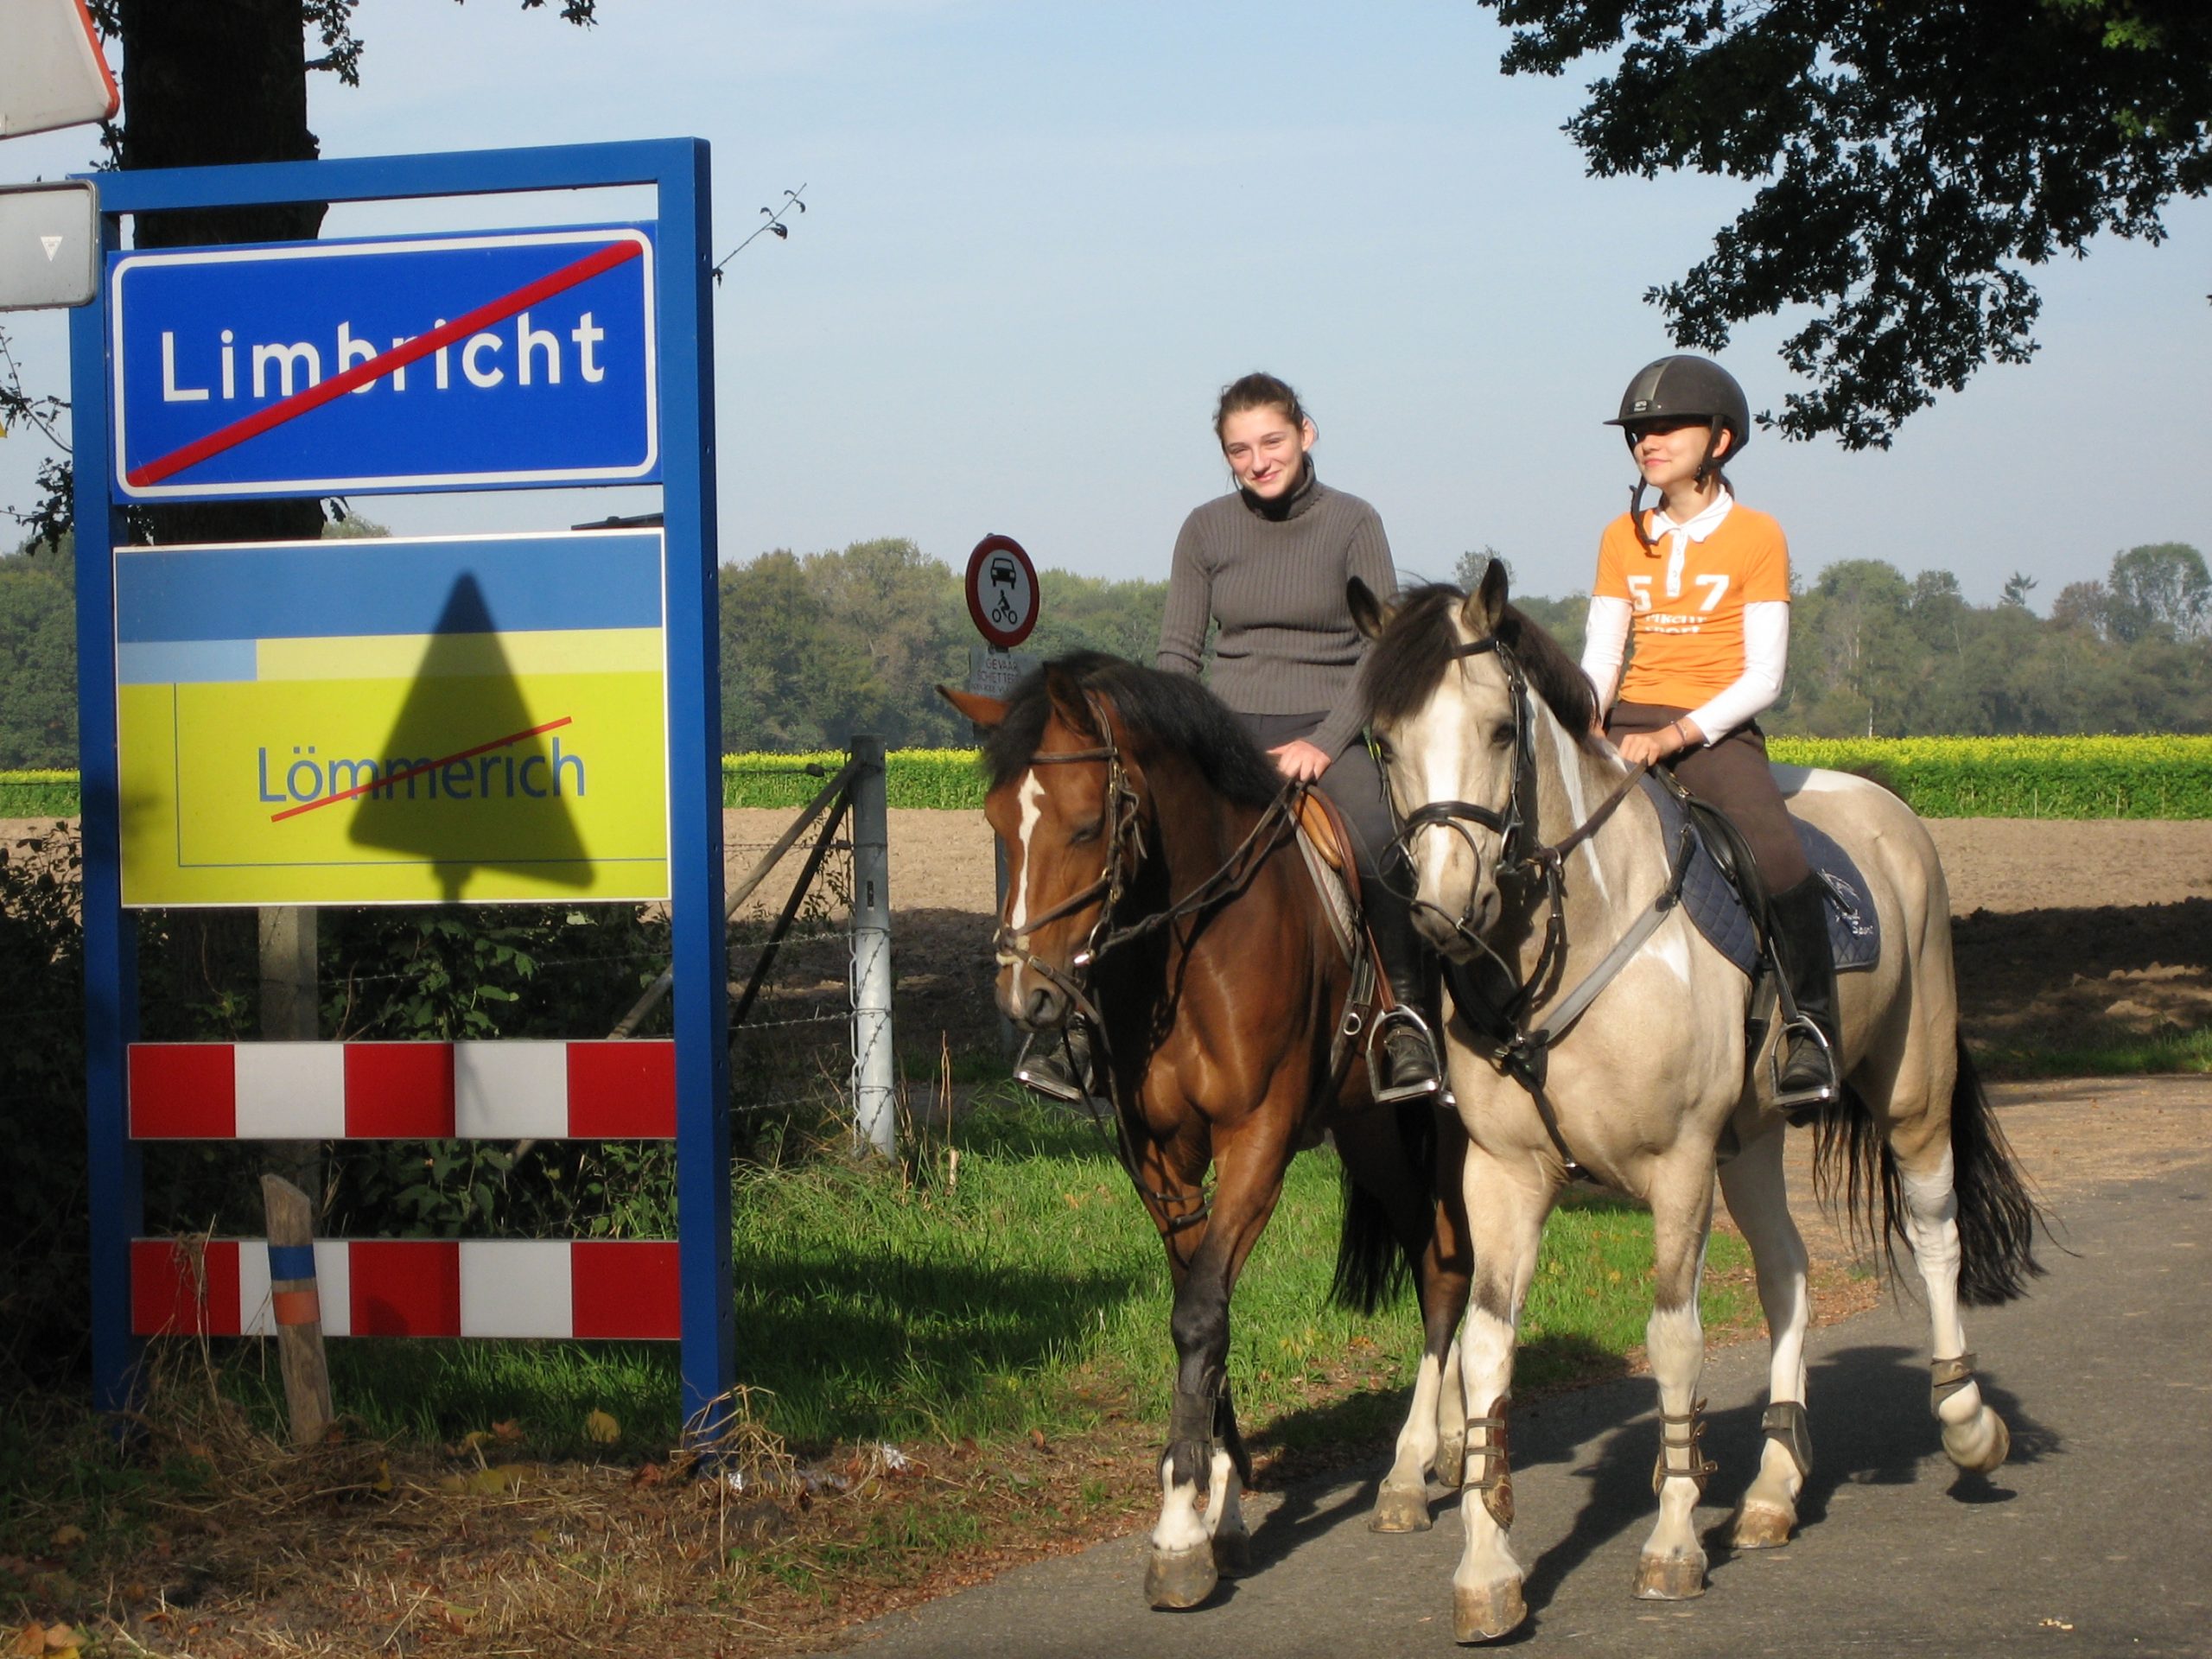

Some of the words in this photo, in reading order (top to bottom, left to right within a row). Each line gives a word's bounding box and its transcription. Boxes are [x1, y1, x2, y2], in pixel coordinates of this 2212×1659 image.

[162, 311, 606, 403] Limbricht
[1627, 575, 1653, 611] 5
[1694, 573, 1731, 612] 7
[257, 737, 586, 803] Lömmerich
